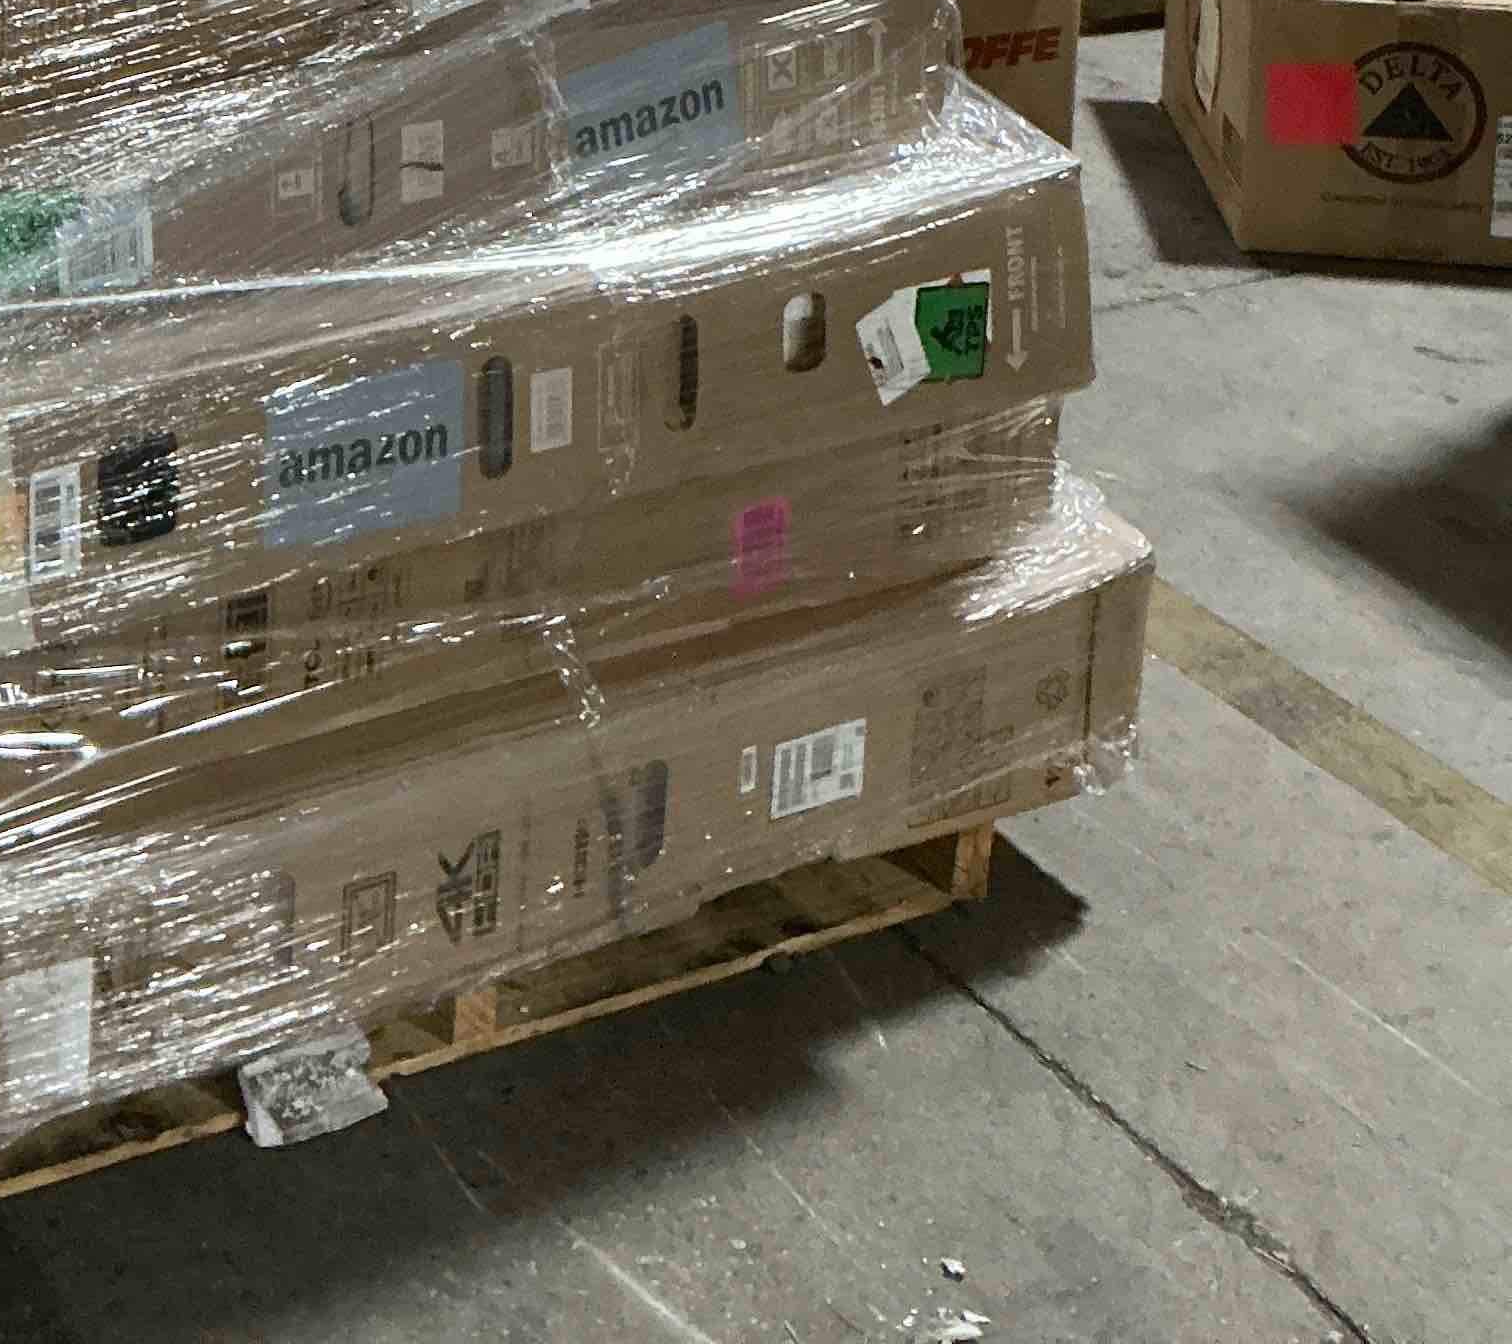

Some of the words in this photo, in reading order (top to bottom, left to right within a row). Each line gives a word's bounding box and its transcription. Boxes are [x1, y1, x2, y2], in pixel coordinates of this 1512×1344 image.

[1357, 54, 1467, 101] DELTA
[574, 78, 726, 159] amazon
[1005, 224, 1026, 302] FRONT
[278, 422, 450, 489] amazon
